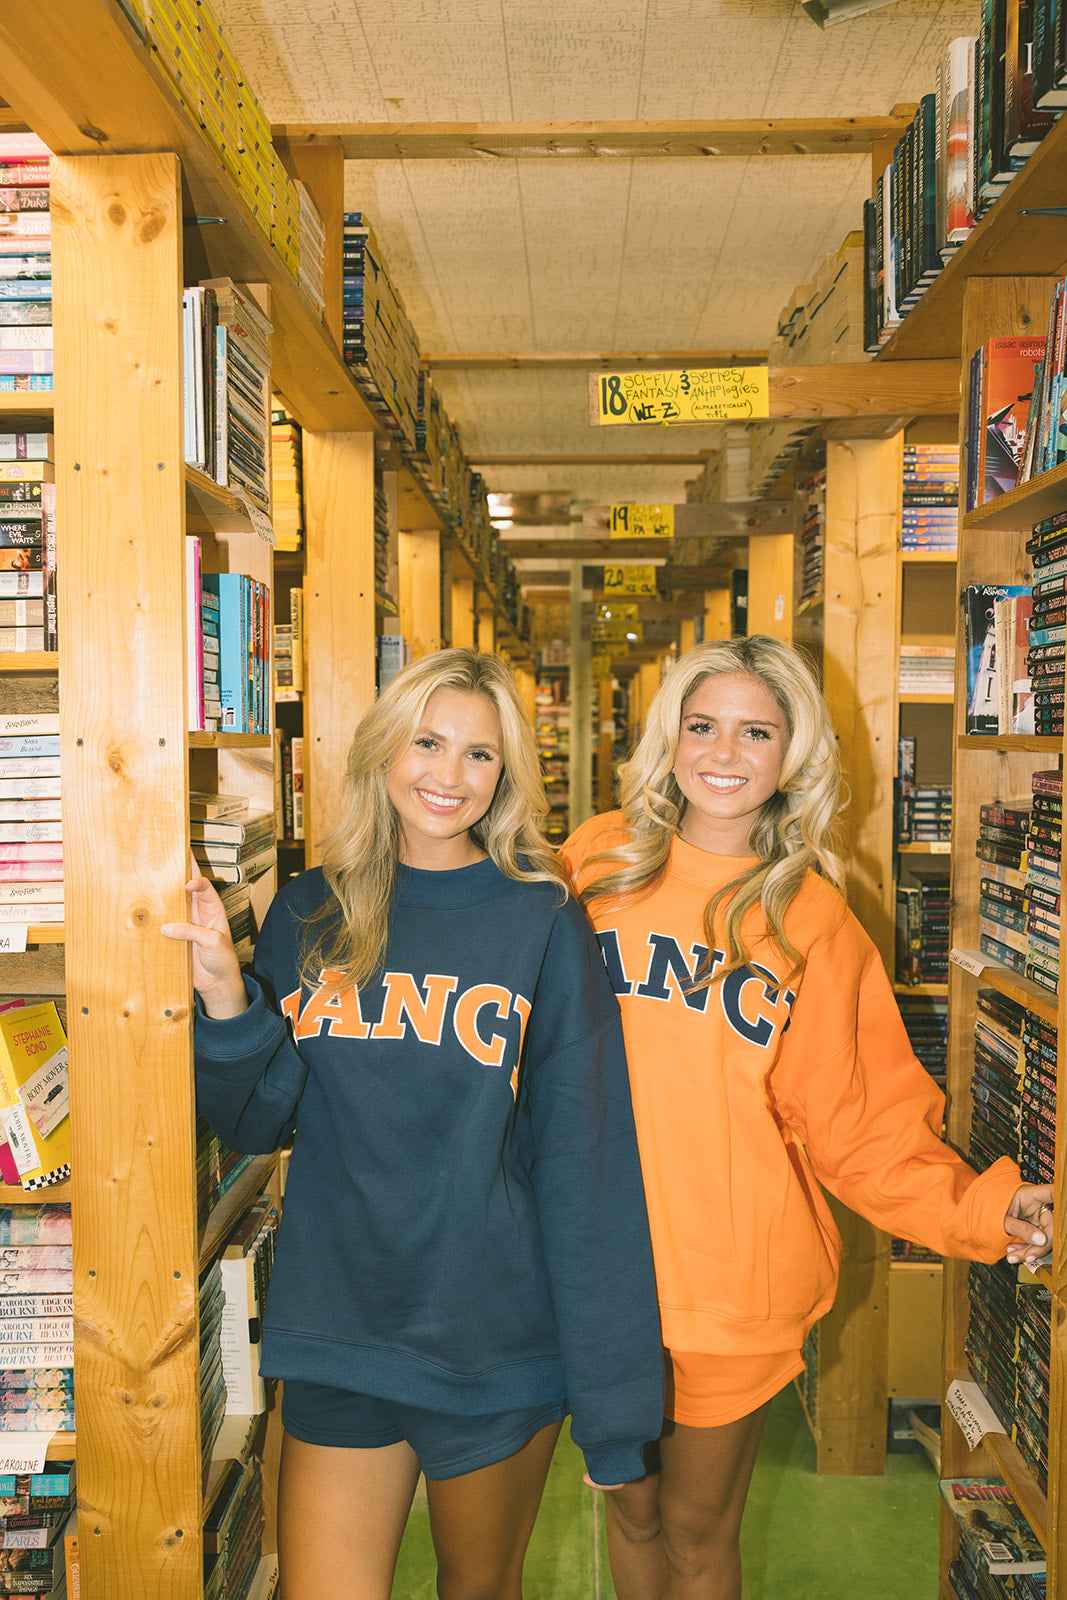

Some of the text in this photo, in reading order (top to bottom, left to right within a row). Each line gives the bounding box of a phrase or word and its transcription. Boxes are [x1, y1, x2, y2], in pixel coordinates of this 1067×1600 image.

[21, 197, 48, 209] Duke
[994, 340, 1017, 349] isaac
[1019, 348, 1046, 357] robots
[601, 375, 628, 416] 18
[626, 385, 679, 400] FANTASY
[613, 506, 628, 531] 19
[0, 524, 27, 532] WHERE
[13, 1024, 52, 1047] STEPHANIE
[25, 1040, 47, 1057] BOND
[26, 1081, 44, 1102] BODY
[0, 1299, 37, 1307] CAROLINE
[41, 1298, 63, 1306] EDGE
[0, 1305, 73, 1316] BOURNE HEAVEN
[39, 1322, 60, 1330] EDGE
[61, 1322, 71, 1330] OF
[40, 1330, 70, 1338] HEAVEN
[1, 1346, 39, 1354] CAROLINE
[43, 1346, 65, 1354] EDGE
[0, 1355, 37, 1365] BOURNE
[0, 1458, 39, 1471] CAROLINE
[5, 1536, 40, 1547] EARLS
